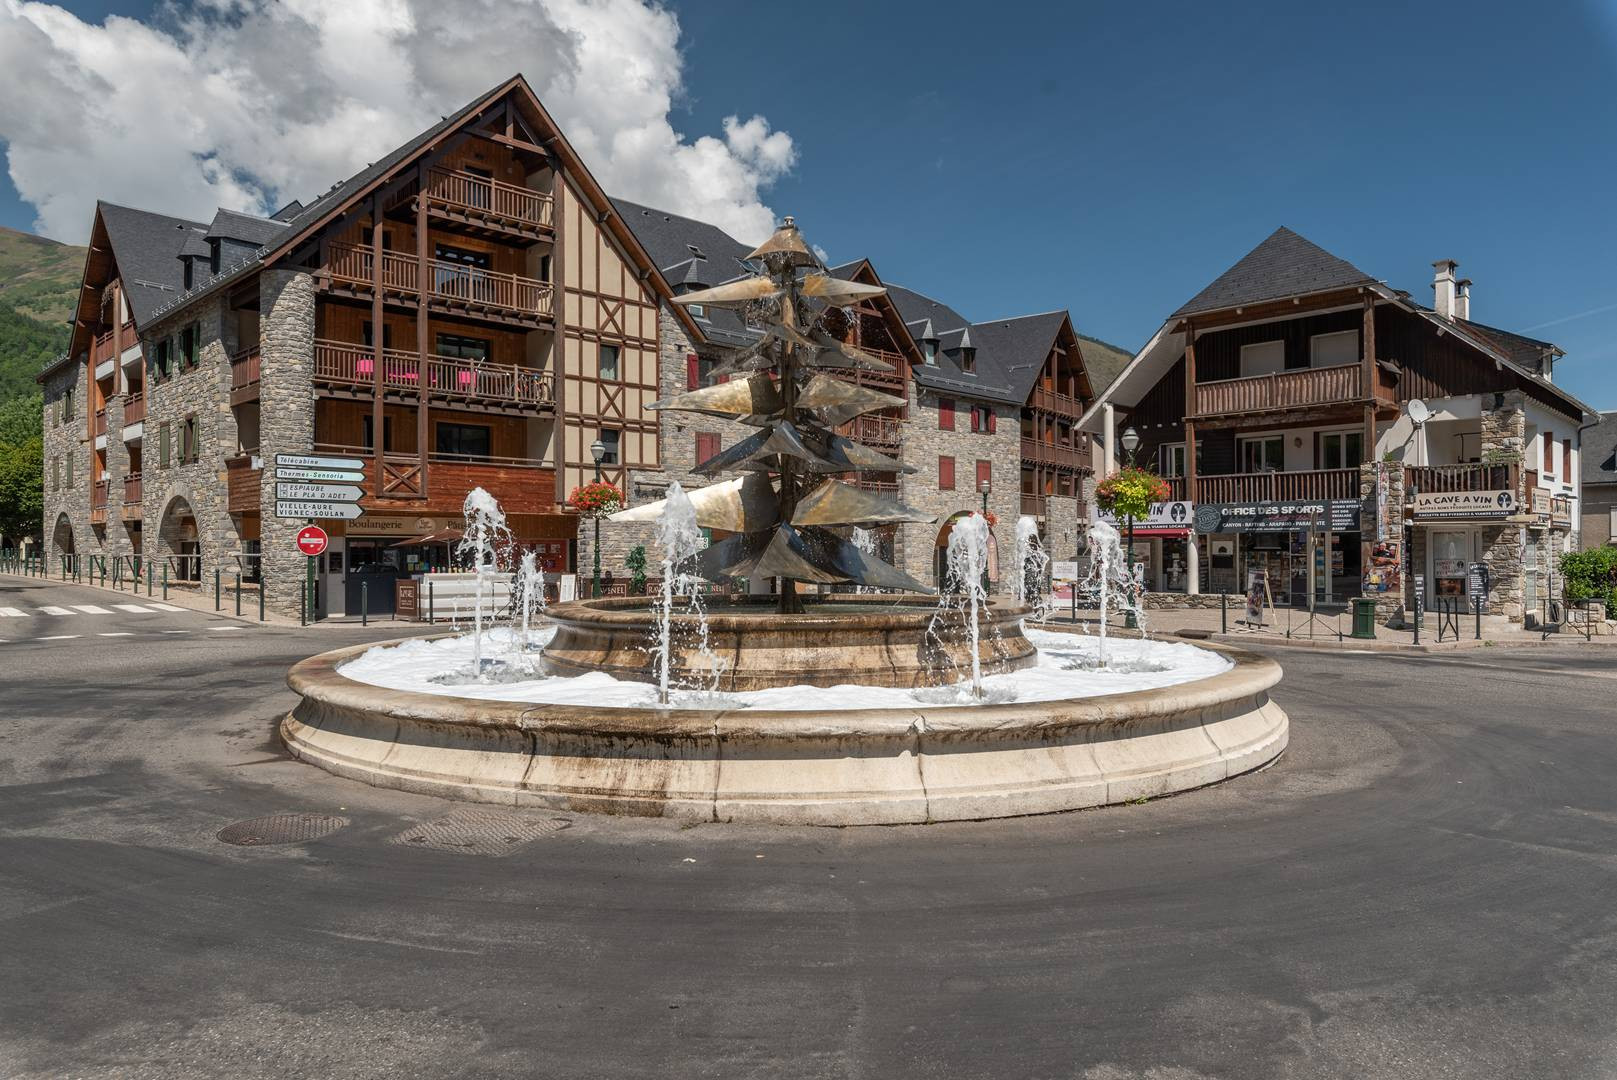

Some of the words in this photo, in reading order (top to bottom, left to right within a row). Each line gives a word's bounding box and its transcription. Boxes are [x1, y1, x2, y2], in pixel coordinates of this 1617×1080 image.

[1434, 496, 1460, 504] CAVE
[1221, 507, 1256, 515] OFFICE
[1258, 506, 1279, 514] DES
[1281, 505, 1324, 514] SPORTS
[349, 520, 402, 530] Boulangerie
